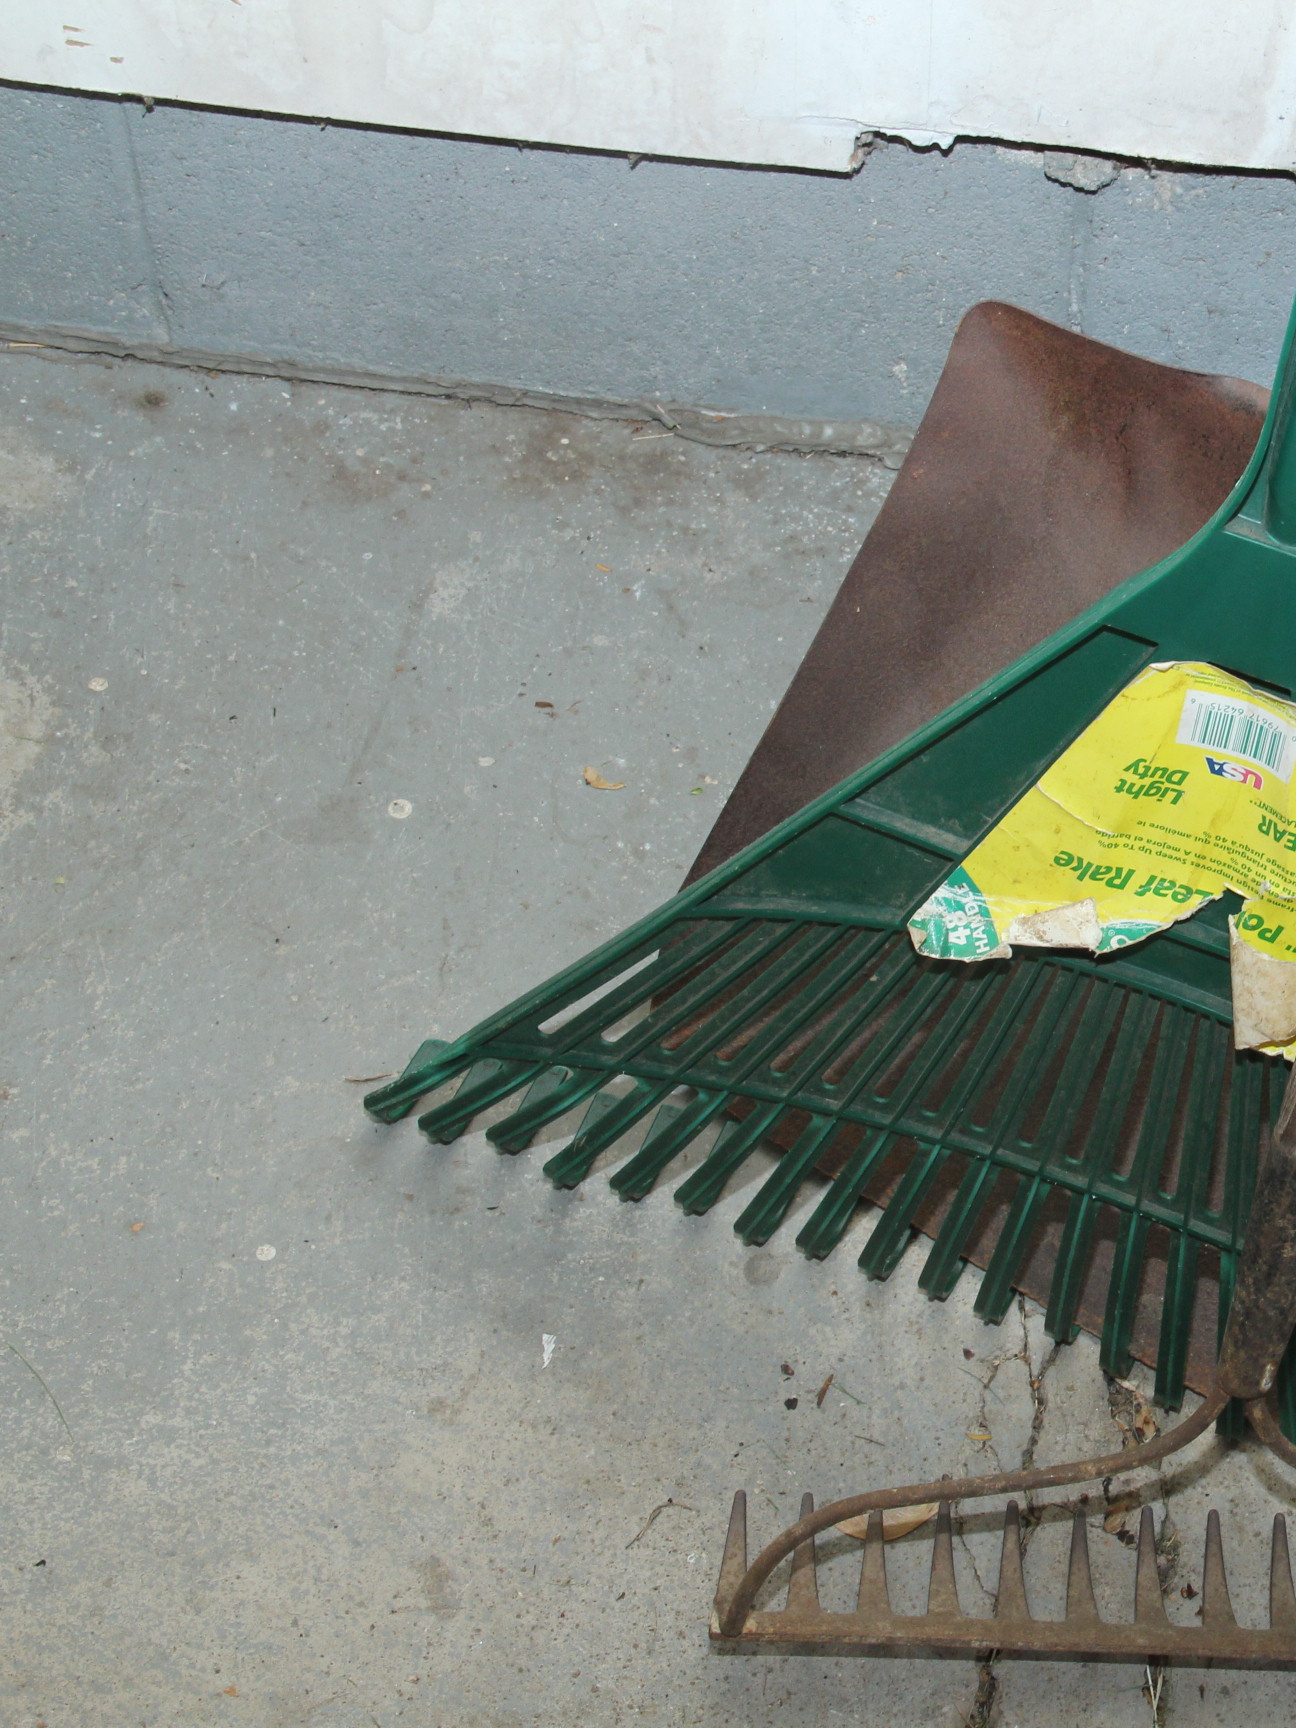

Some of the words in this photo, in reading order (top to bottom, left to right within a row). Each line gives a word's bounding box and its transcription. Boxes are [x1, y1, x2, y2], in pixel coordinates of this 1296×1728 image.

[1210, 702, 1244, 716] 64215
[1248, 713, 1279, 732] 79617
[1122, 758, 1190, 786] Duty
[1205, 756, 1263, 790] USA
[1114, 778, 1185, 805] Light
[1095, 829, 1132, 840] barrido
[1149, 822, 1192, 838] améliore
[1203, 831, 1212, 839] %
[1098, 839, 1120, 849] 40%
[1122, 842, 1136, 850] To
[1146, 839, 1182, 852] mejora
[1194, 836, 1211, 845] qui
[1138, 846, 1152, 855] Up
[1194, 853, 1207, 861] en
[1213, 841, 1267, 870] triangulaire
[1155, 850, 1187, 865] Sweep
[1230, 857, 1239, 866] %
[1053, 850, 1136, 890] Rake
[1190, 862, 1234, 882] Improves
[1209, 855, 1249, 878] armazón
[1241, 863, 1253, 872] 40
[1250, 877, 1261, 887] de
[1255, 871, 1267, 880] un
[1268, 879, 1280, 888] en
[1235, 911, 1284, 943] Pol
